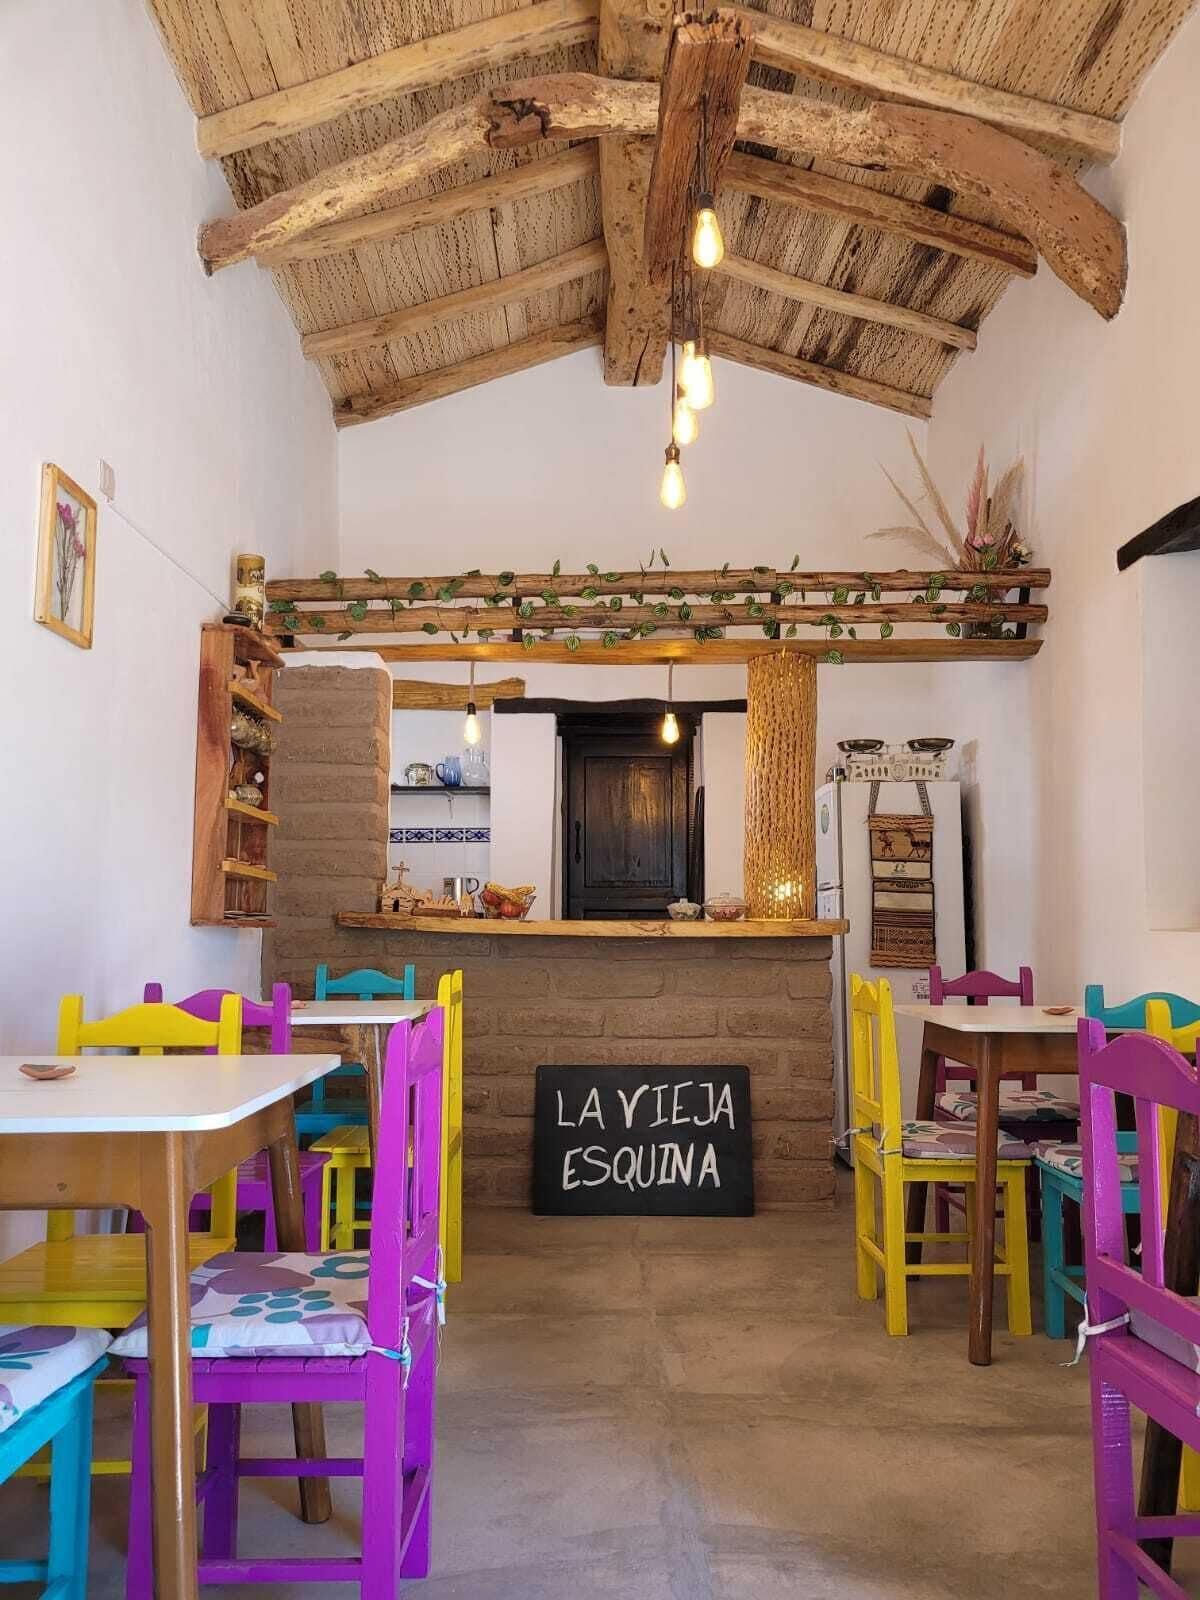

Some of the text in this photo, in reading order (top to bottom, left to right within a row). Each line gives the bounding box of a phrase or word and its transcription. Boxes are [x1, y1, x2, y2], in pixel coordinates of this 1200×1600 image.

[557, 1080, 735, 1130] LA VIEJA
[562, 1142, 721, 1192] ESQUINA
